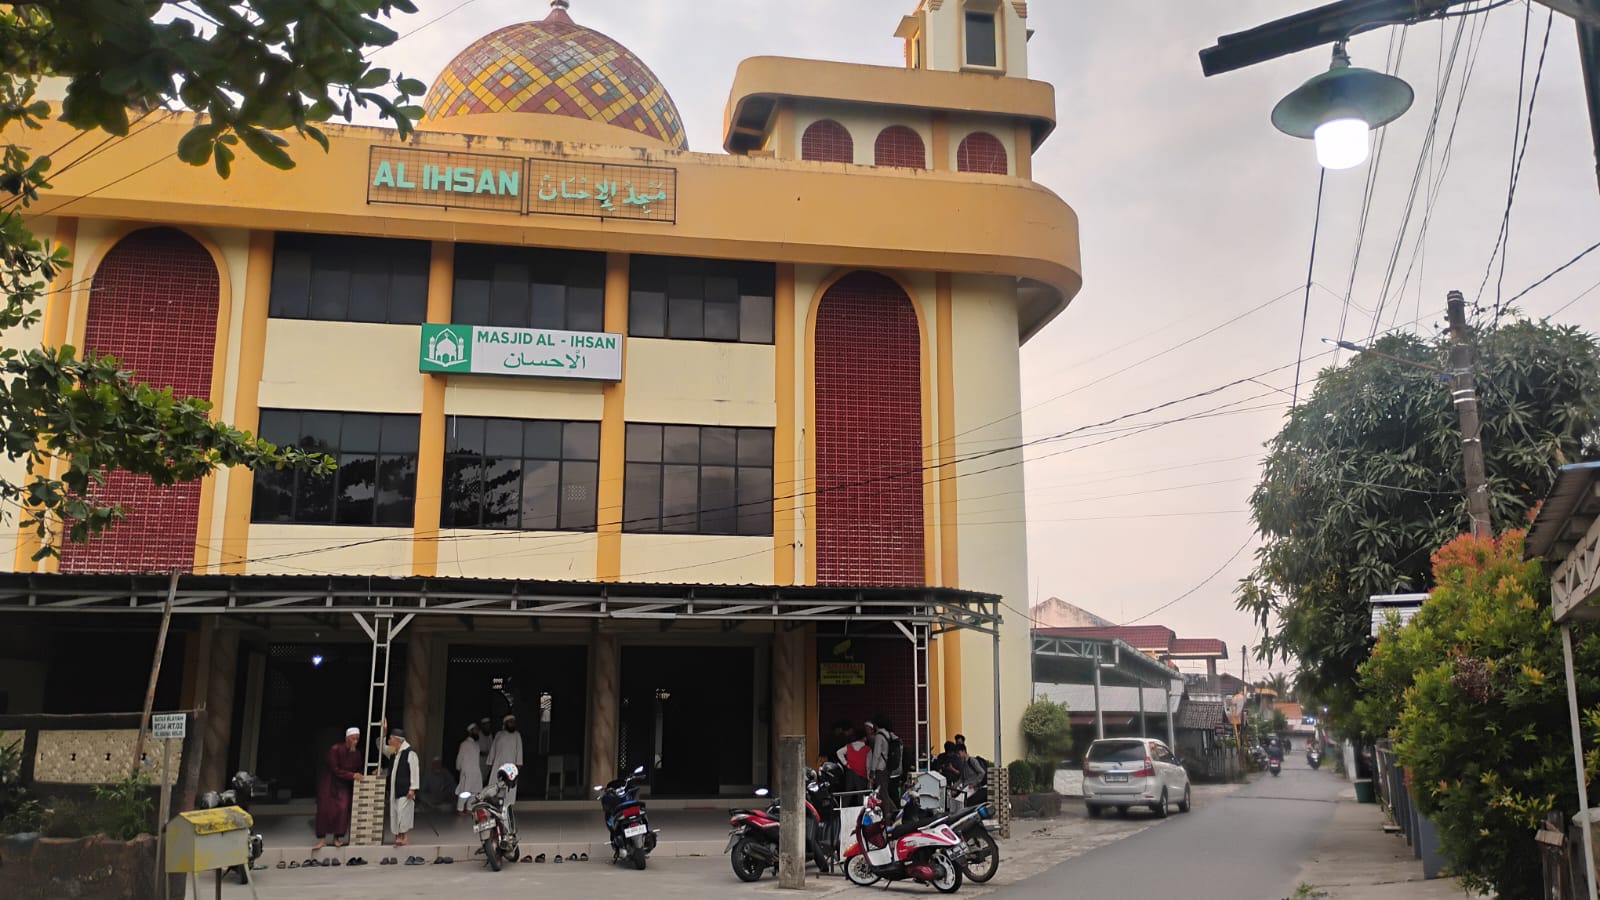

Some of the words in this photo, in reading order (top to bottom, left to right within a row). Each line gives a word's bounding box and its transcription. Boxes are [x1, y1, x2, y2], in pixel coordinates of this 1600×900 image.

[373, 160, 415, 188] AL
[423, 164, 519, 196] IHSAN
[477, 330, 533, 345] MASJID
[536, 334, 555, 346] AL
[570, 335, 616, 349] IHSAN
